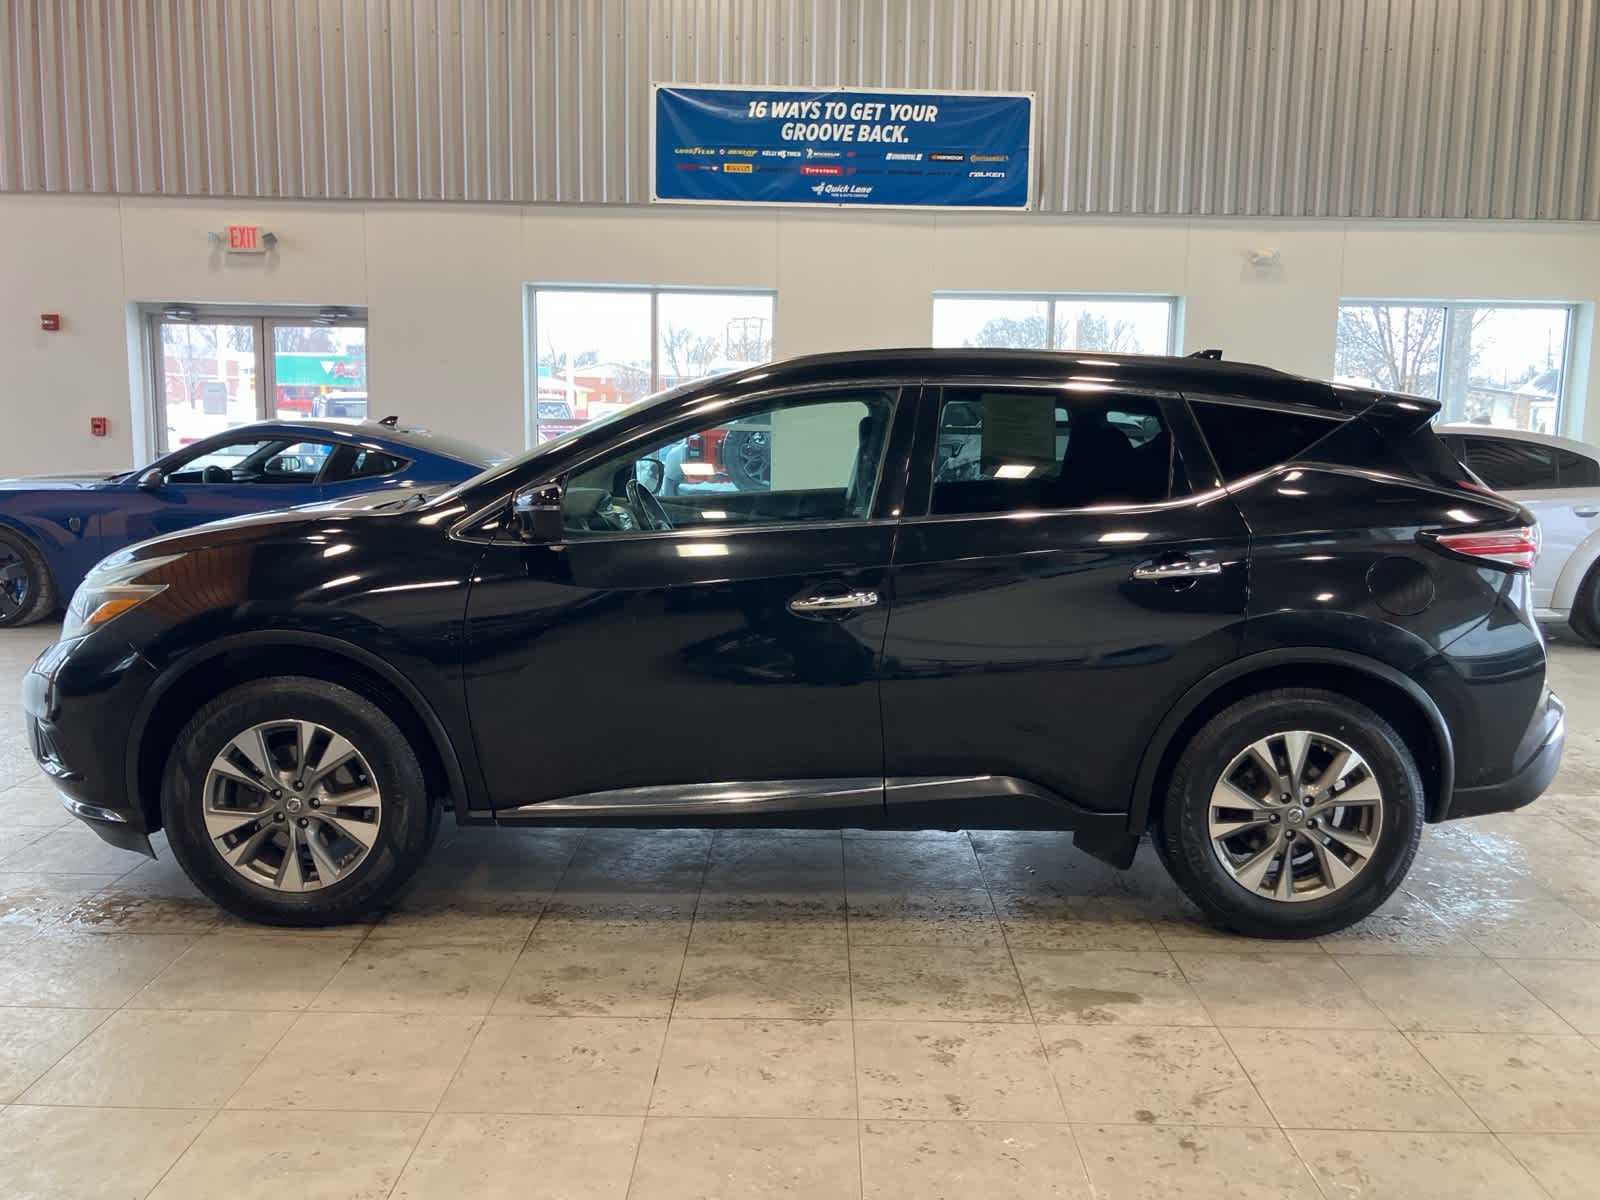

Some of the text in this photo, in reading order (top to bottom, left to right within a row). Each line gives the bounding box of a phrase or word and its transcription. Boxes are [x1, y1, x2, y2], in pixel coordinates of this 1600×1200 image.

[748, 101, 939, 122] 16 WAYS TO GET YOUR
[781, 122, 909, 143] GROOVE BACK.
[824, 184, 873, 194] Quick Lane
[229, 226, 257, 249] EXIT
